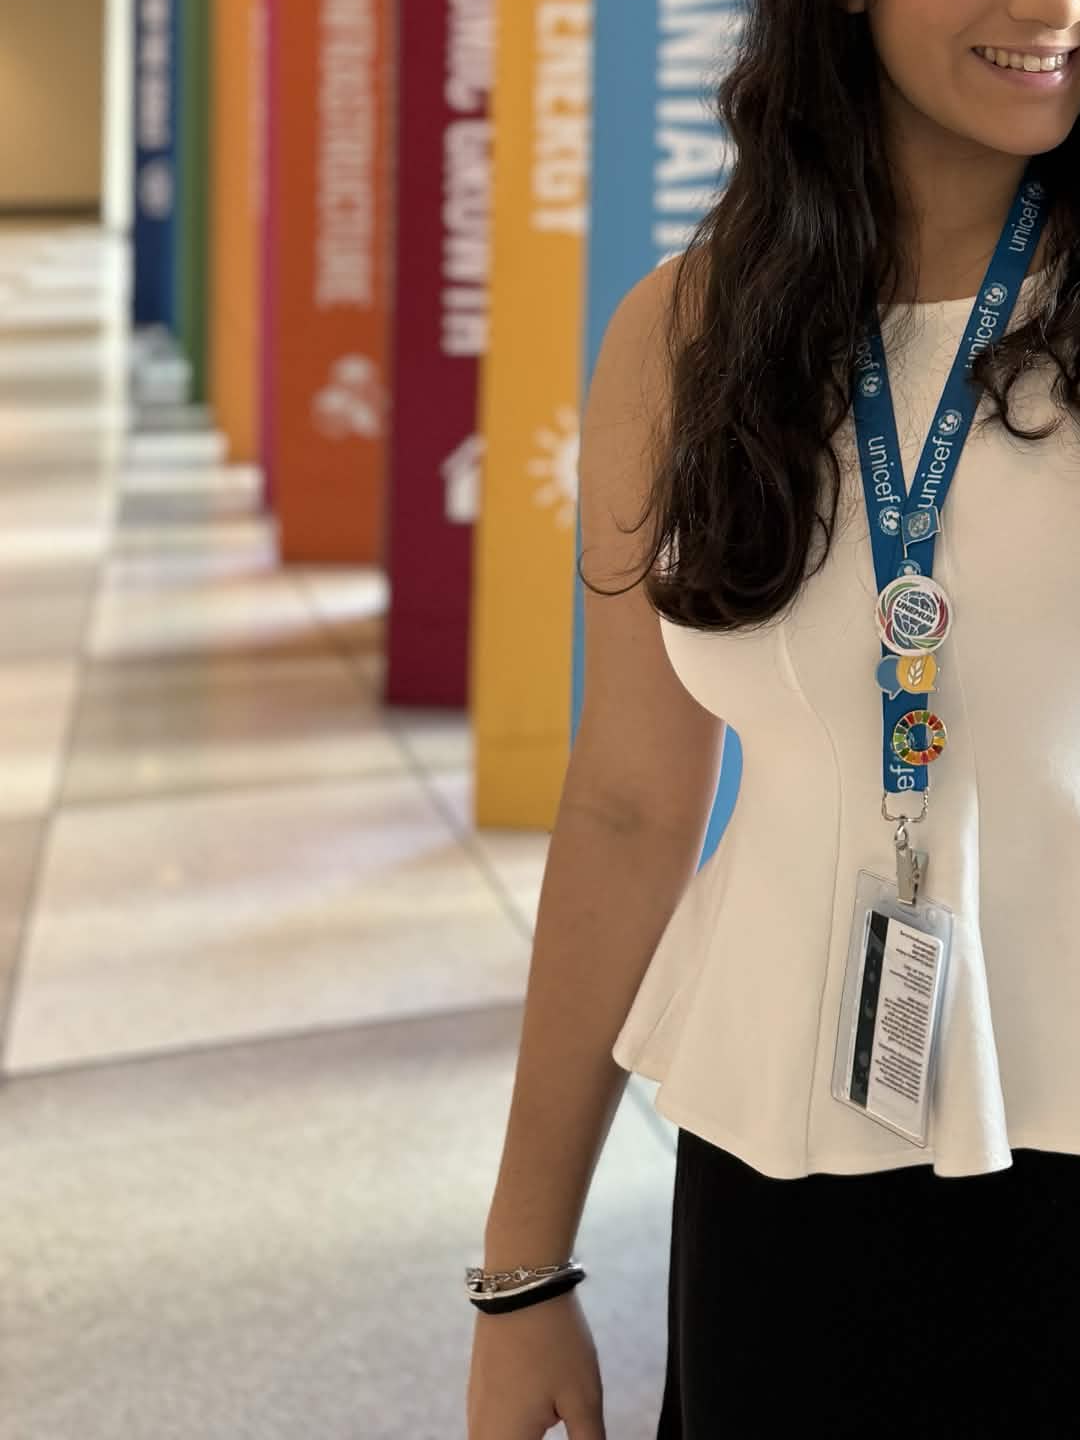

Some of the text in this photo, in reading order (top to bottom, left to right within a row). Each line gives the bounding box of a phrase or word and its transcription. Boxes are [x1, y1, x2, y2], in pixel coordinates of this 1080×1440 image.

[1008, 198, 1042, 253] unicef
[867, 434, 901, 503] unicef
[917, 436, 953, 510] unicef
